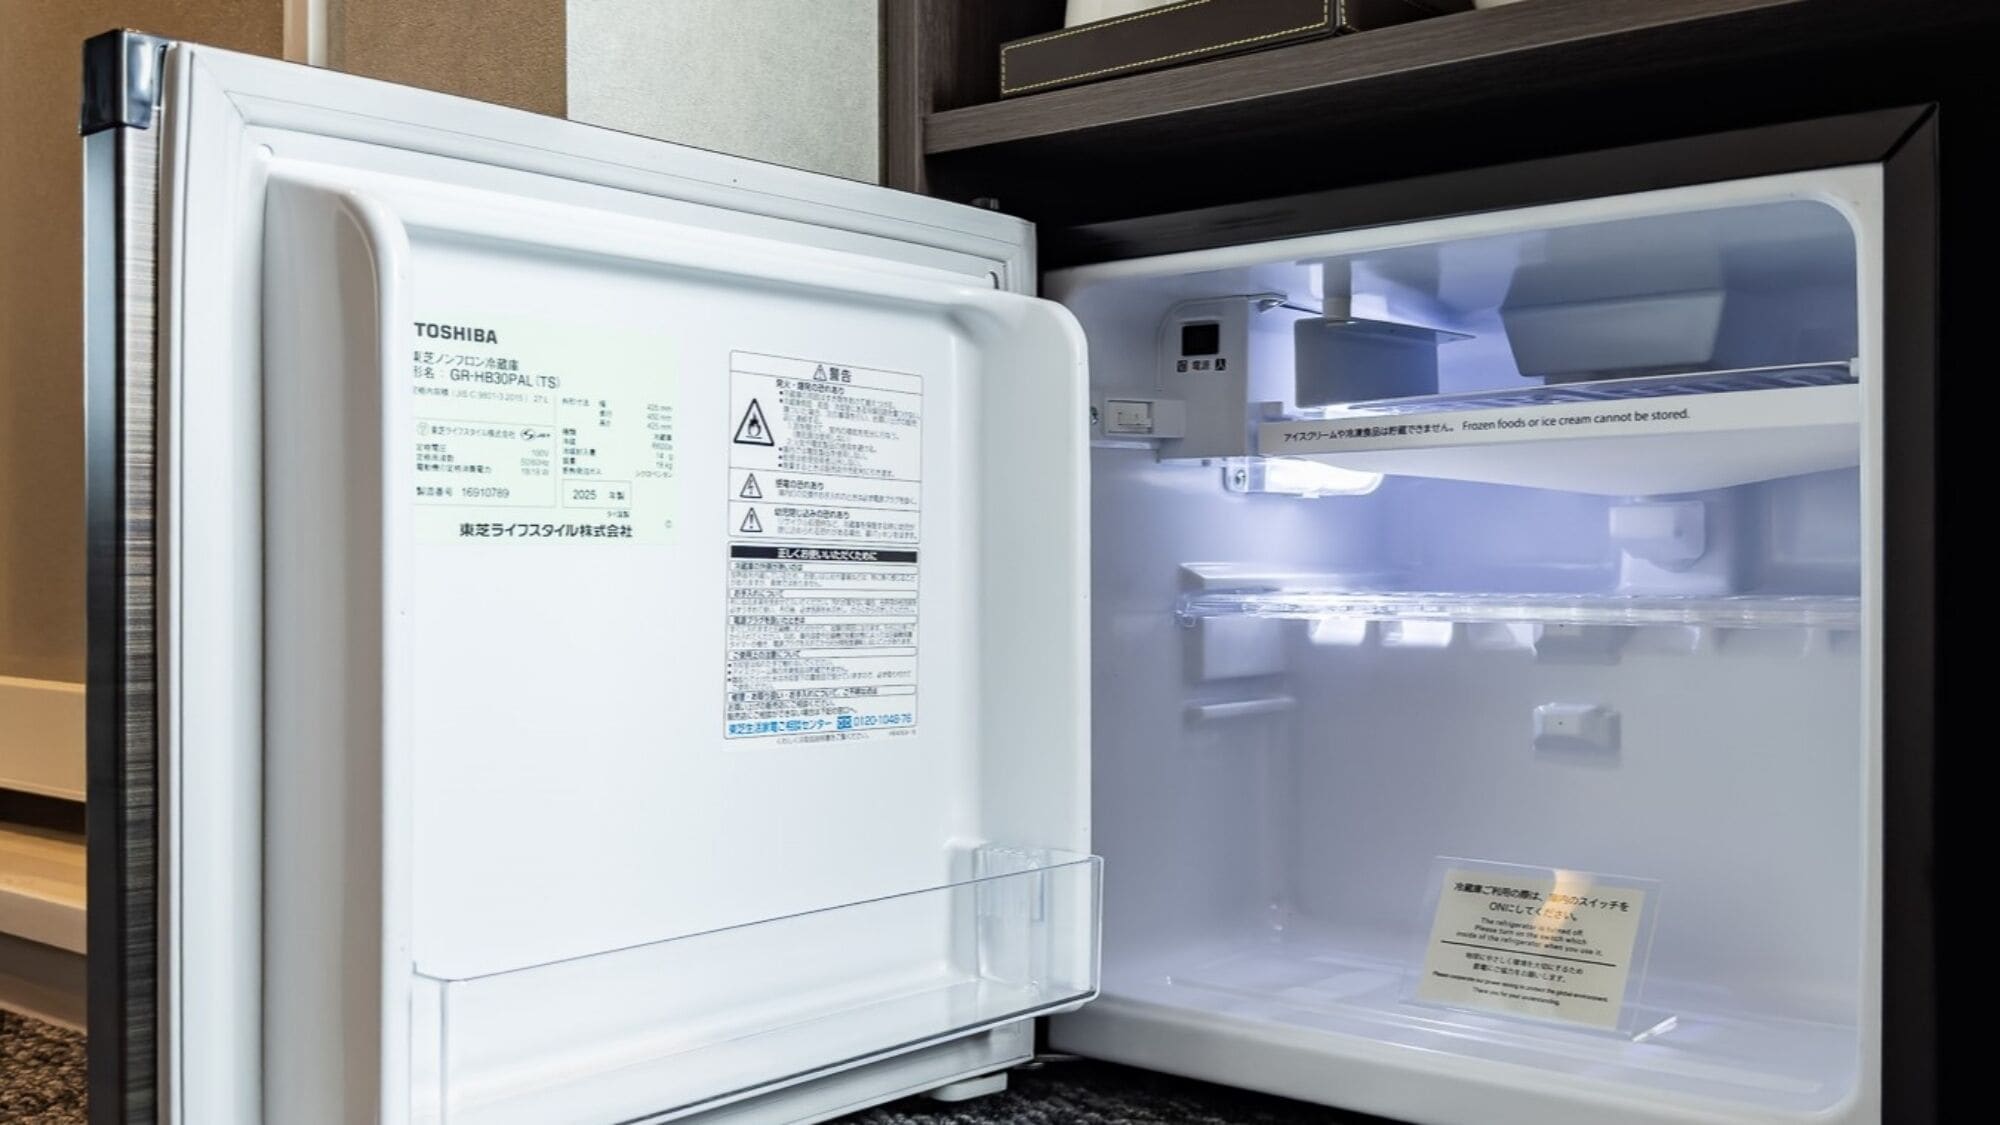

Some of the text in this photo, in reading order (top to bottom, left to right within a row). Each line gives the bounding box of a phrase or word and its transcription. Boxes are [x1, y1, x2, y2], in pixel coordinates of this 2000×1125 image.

[414, 322, 498, 344] TOSHIBA
[829, 367, 851, 383] 警告
[1462, 420, 1496, 431] Frozen
[1497, 418, 1526, 429] foods
[1528, 418, 1539, 428] or
[1541, 416, 1557, 427] ice
[1558, 415, 1592, 426] cream
[1594, 413, 1632, 424] cannot
[1634, 410, 1649, 421] be
[1651, 408, 1690, 420] stored.
[573, 489, 597, 500] 2025
[459, 523, 633, 538] 東芝ライフスタイル株式会社
[1481, 917, 1494, 925] The
[1496, 919, 1537, 931] refrigerator
[1455, 931, 1477, 939] inside
[1478, 932, 1487, 940] of
[1487, 934, 1499, 942] the
[1501, 936, 1541, 947] refrigerator
[1543, 942, 1563, 951] when
[1565, 945, 1579, 953] you
[1474, 924, 1497, 934] Please
[1499, 928, 1514, 936] turn
[1526, 931, 1538, 939] the
[1565, 937, 1587, 945] which
